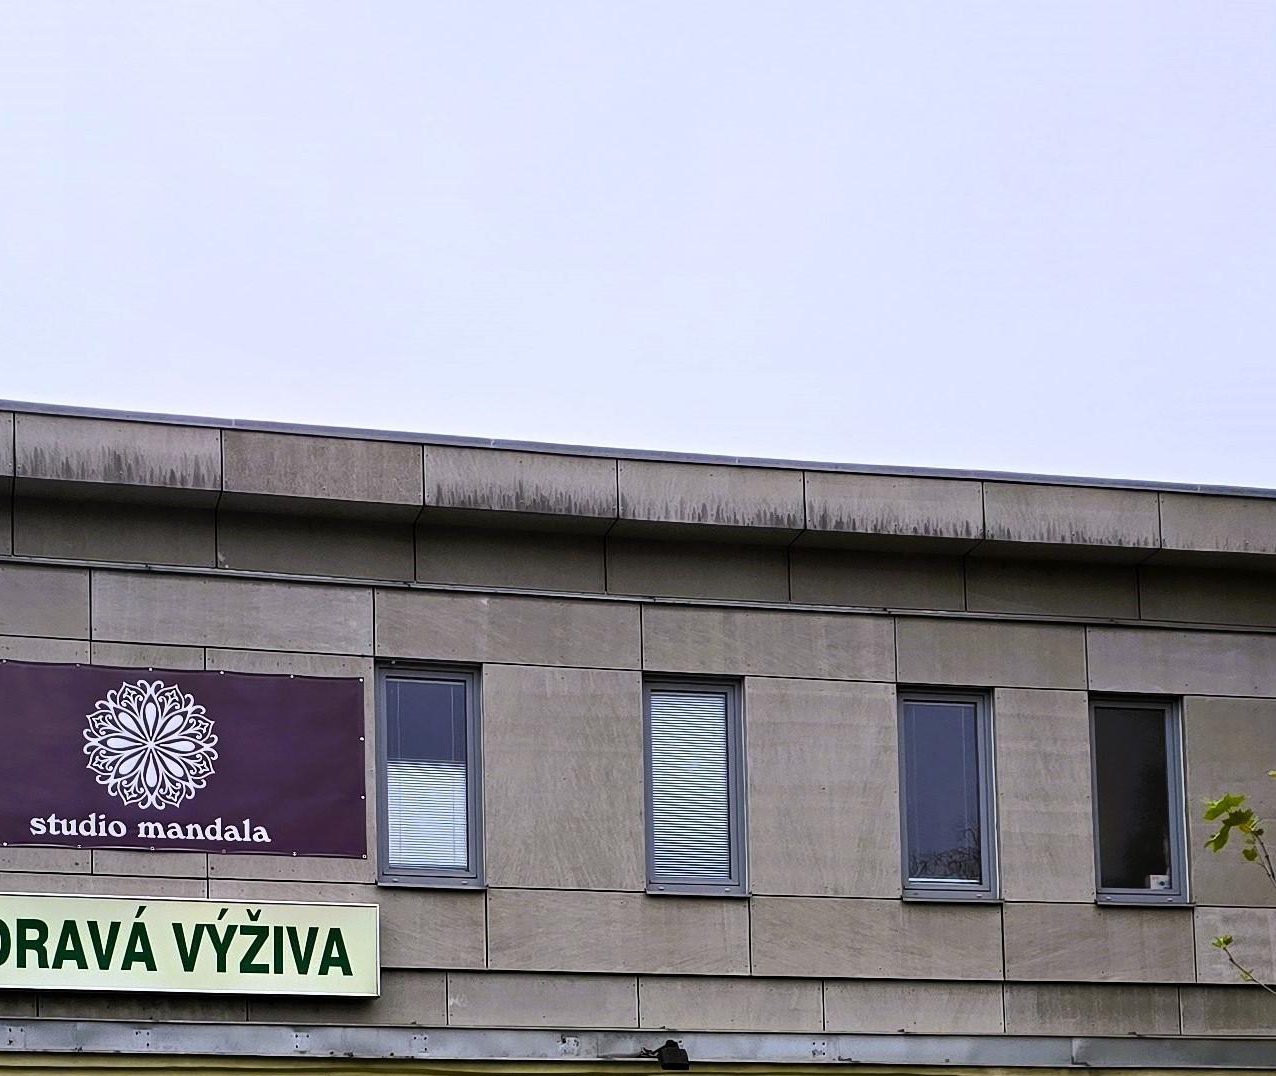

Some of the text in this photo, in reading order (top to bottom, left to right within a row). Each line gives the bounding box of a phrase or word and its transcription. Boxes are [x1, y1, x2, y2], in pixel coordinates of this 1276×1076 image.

[29, 813, 272, 843] studio mandala
[171, 908, 354, 977] VÝŽIVA
